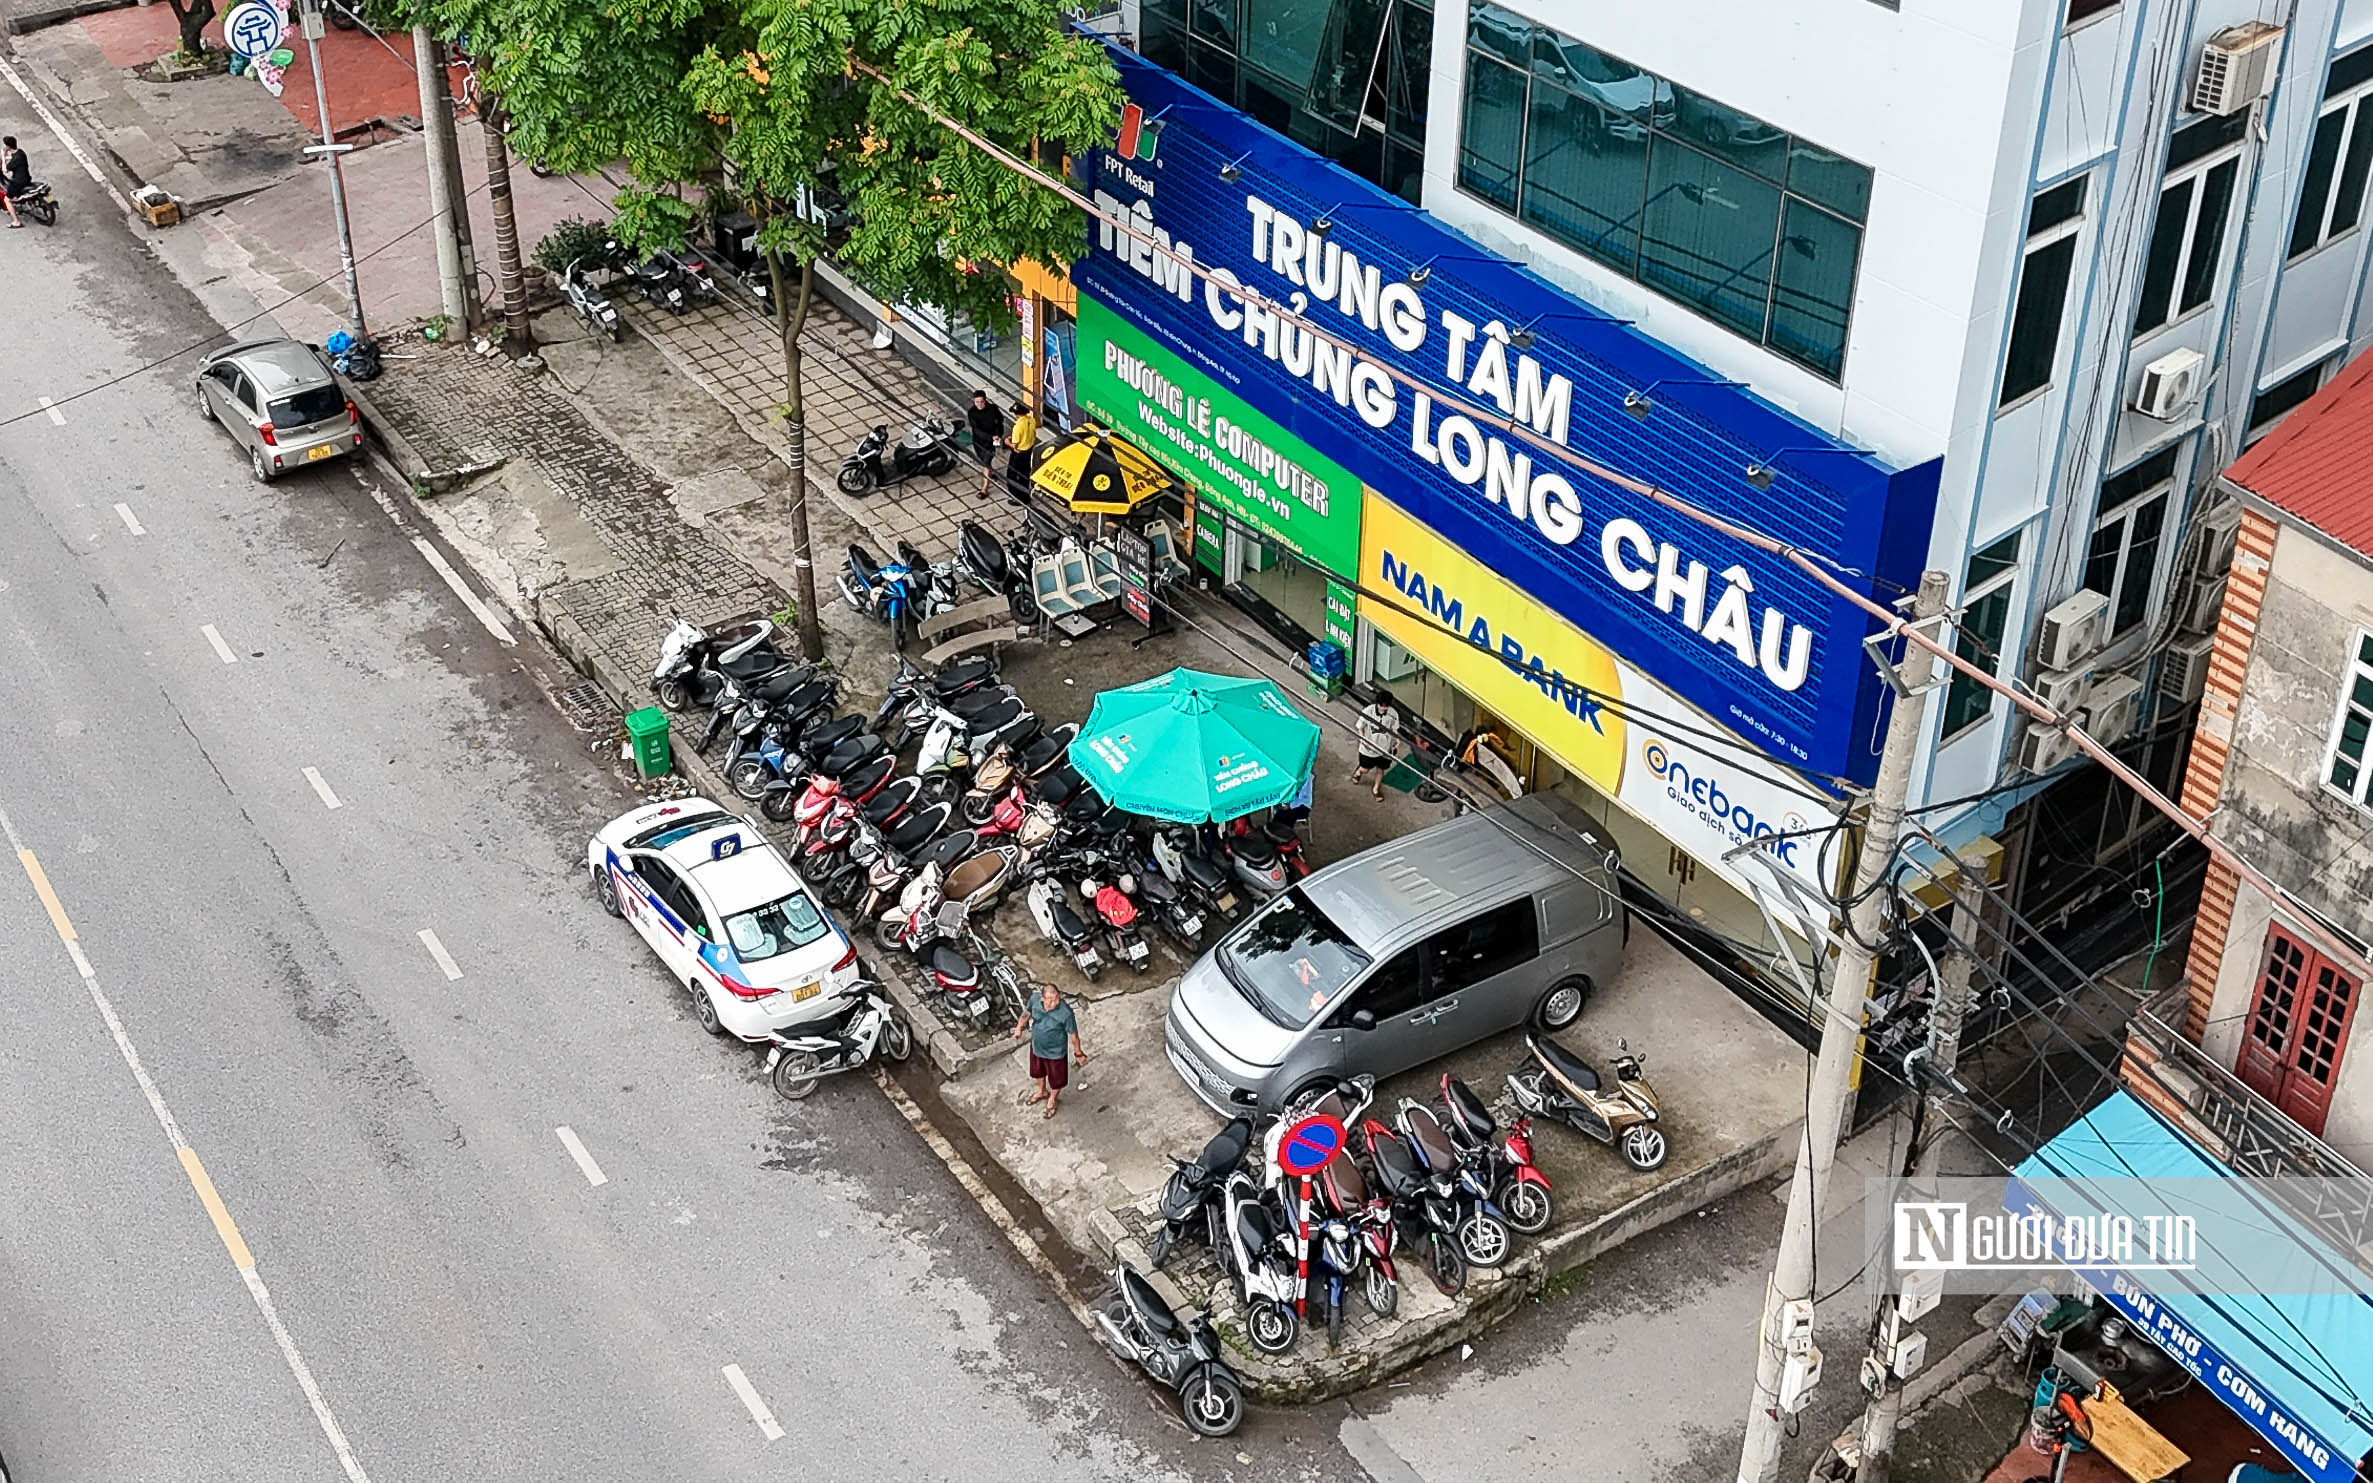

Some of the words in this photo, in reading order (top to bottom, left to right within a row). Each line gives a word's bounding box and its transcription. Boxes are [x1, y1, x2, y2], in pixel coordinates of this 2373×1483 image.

[1105, 154, 1123, 178] FPT
[1125, 167, 1154, 197] Retail
[1247, 195, 1427, 352] TRUNG
[1442, 310, 1572, 446] TÂM
[1094, 189, 1193, 302] TIÊM
[1205, 266, 1398, 429] CHỦNG
[1412, 391, 1584, 545] LONG
[1600, 517, 1813, 692] CHÂU
[1104, 339, 1184, 419] PHƯƠNG
[1186, 395, 1211, 438] LÊ
[1215, 416, 1330, 518] COMPUTER
[1382, 549, 1463, 633] NAM
[1468, 616, 1493, 651] A
[1501, 632, 1605, 737] BANK
[1667, 786, 1696, 813] Giao
[1699, 810, 1726, 836] dịch
[1728, 829, 1743, 846] số
[1771, 731, 1786, 746] 7:30
[1790, 742, 1808, 761] 18:30
[2112, 1274, 2156, 1320] BÚN
[2216, 1364, 2267, 1417] CƠM
[2268, 1409, 2331, 1472] RANG
[2149, 1325, 2166, 1345] TÂY
[2166, 1342, 2185, 1361] CAO
[2184, 1357, 2202, 1377] TỐC
